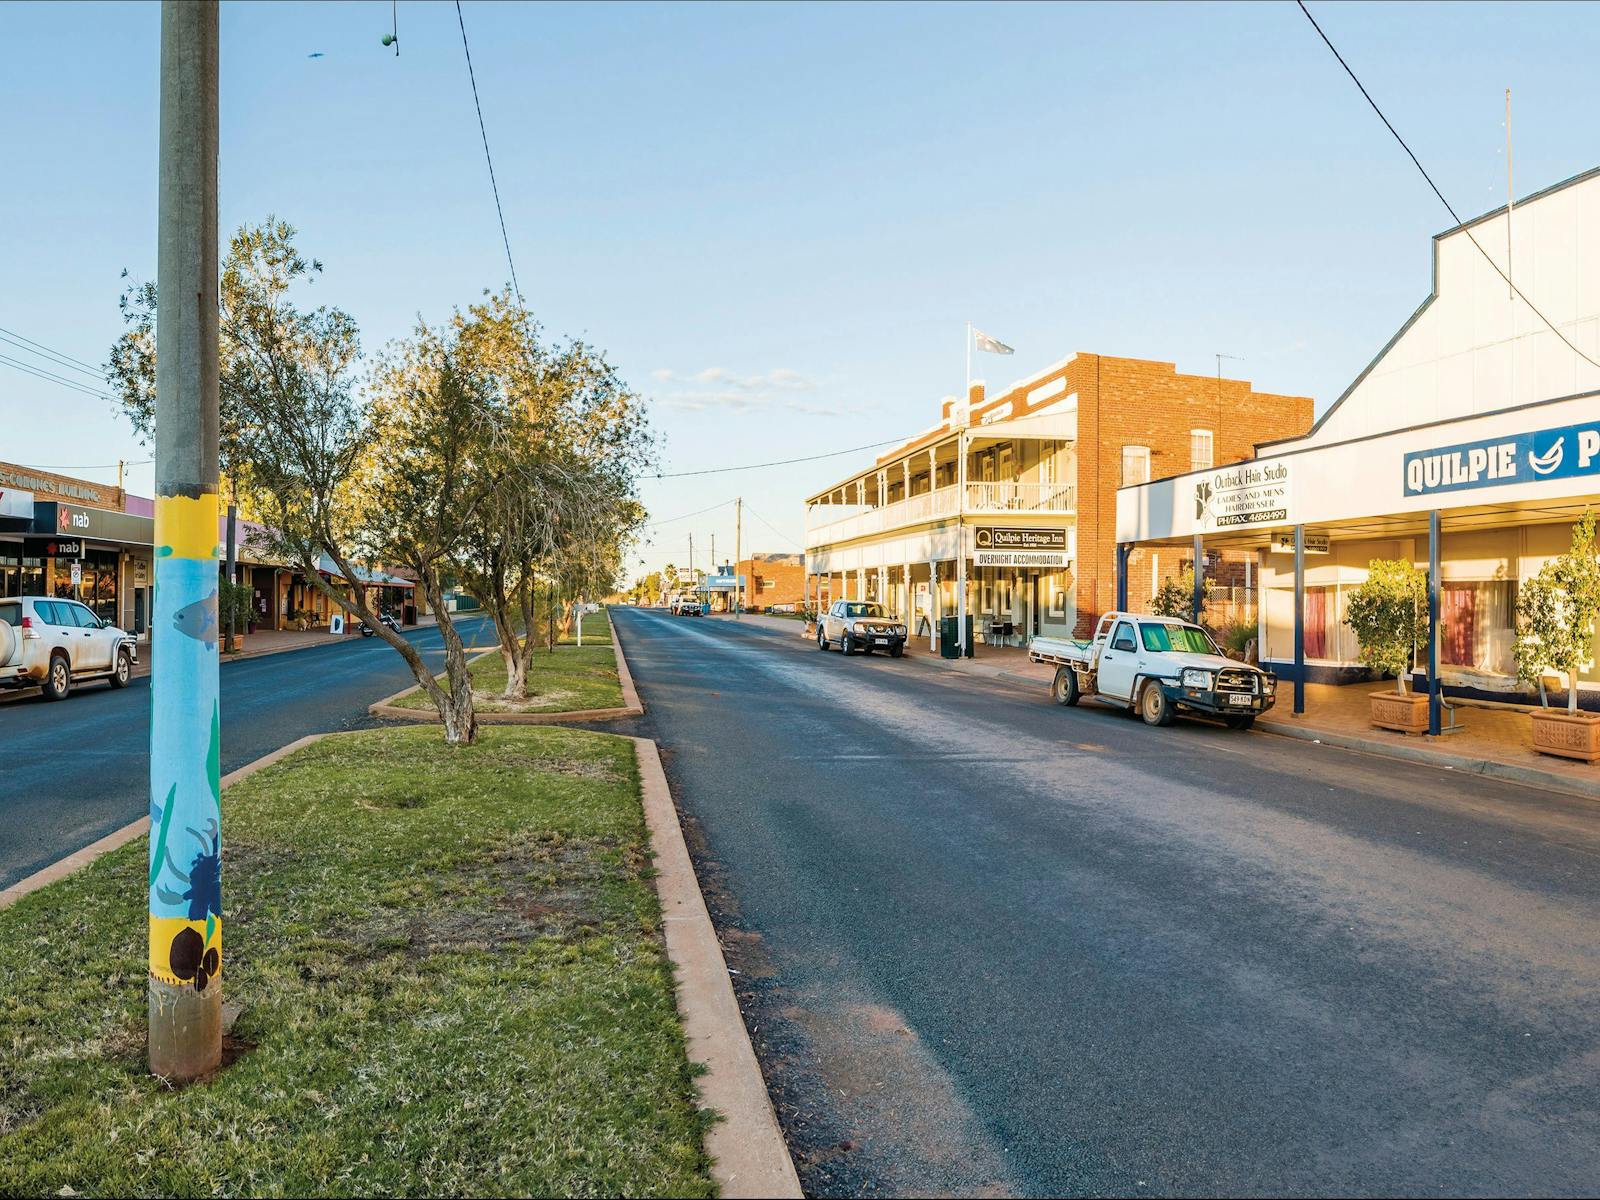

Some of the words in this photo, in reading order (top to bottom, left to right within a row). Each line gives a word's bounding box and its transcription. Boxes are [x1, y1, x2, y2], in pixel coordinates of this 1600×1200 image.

[1245, 469, 1261, 484] Hair
[1264, 463, 1287, 481] Studio
[1407, 443, 1517, 492] QUILPIE
[1217, 494, 1241, 504] LADIES
[1244, 491, 1260, 501] AND
[1263, 488, 1284, 497] MENS
[1225, 499, 1275, 512] HAIRDRESSER
[72, 512, 90, 528] nab
[995, 532, 1021, 544] Quilpie
[1022, 533, 1051, 544] Heritage
[1051, 534, 1064, 543] Inn
[59, 542, 80, 553] nab
[979, 554, 1012, 564] OVERNIGHT
[1013, 554, 1063, 565] ACCOMMODATION
